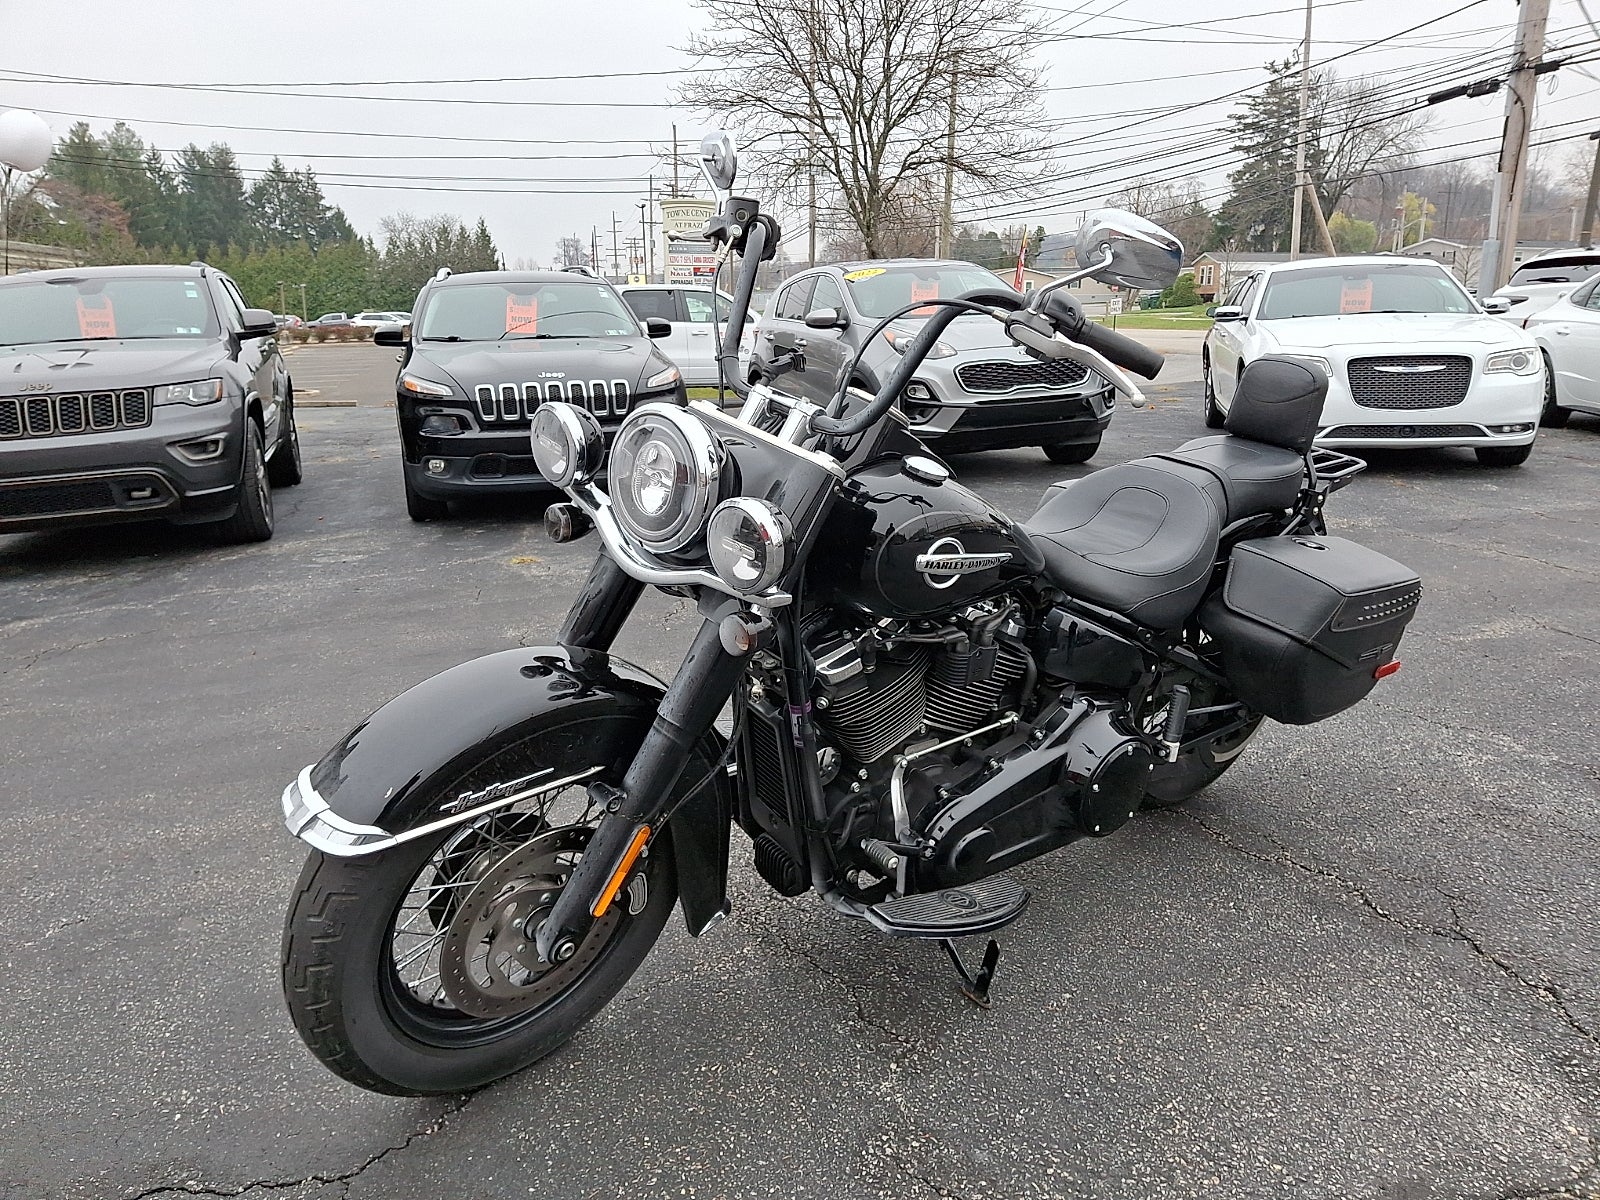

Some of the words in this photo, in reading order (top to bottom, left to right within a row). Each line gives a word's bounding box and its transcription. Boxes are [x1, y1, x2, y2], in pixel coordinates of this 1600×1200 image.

[666, 208, 690, 219] TOWNE
[85, 320, 110, 329] NOW
[511, 315, 533, 324] NOW
[538, 371, 566, 379] Jeep
[19, 382, 54, 393] Jeep
[924, 556, 1001, 570] HARLEY-DAVIDSON
